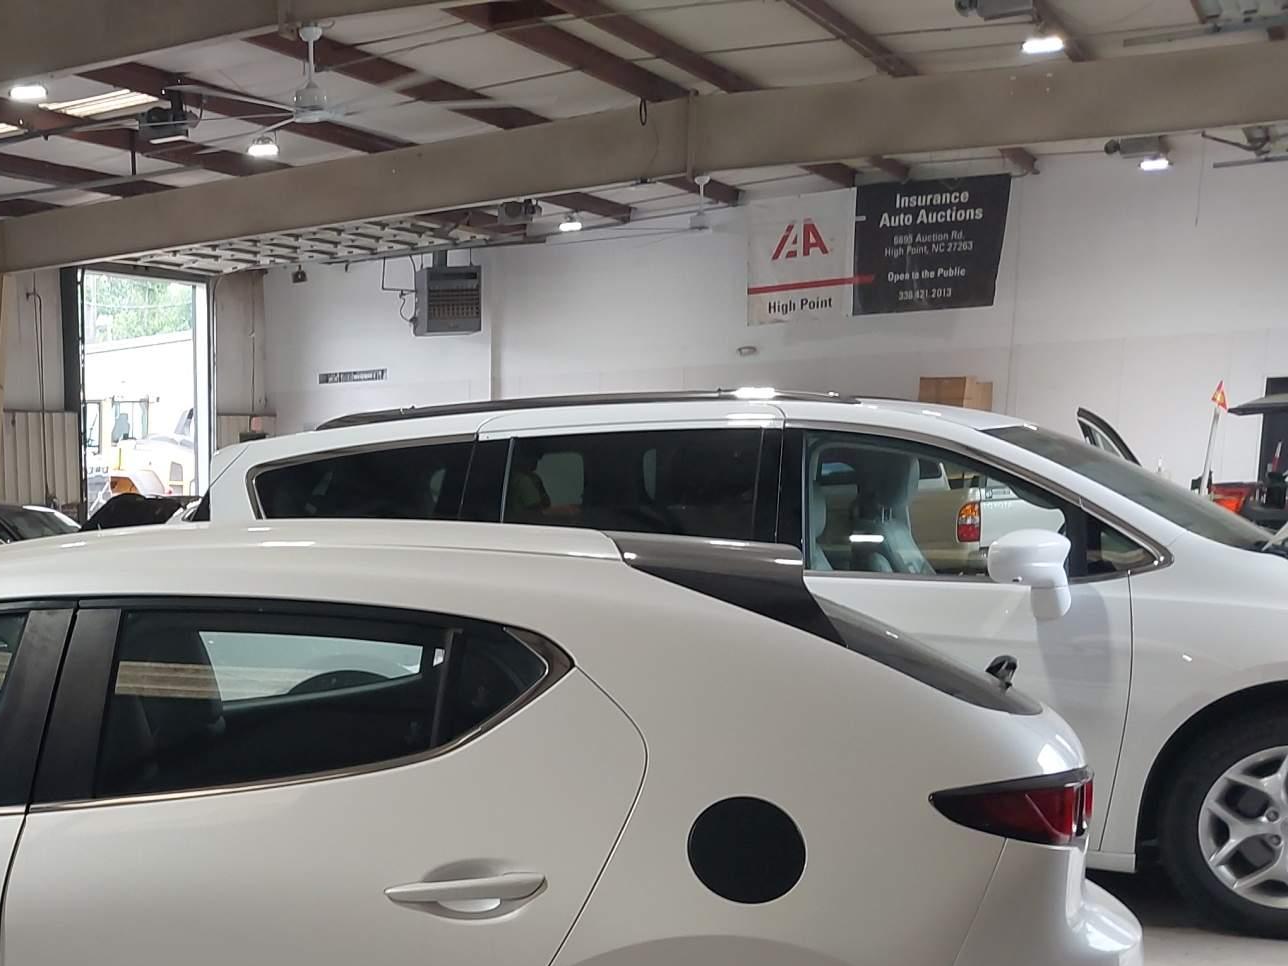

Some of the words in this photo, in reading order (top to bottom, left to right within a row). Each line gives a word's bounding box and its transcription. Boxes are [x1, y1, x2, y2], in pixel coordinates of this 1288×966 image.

[896, 191, 969, 209] Insurance
[879, 212, 913, 228] Auto
[916, 206, 984, 225] Auctions
[915, 232, 949, 243] Auction
[884, 247, 904, 258] High
[931, 242, 945, 253] NC
[888, 271, 910, 283] Open
[911, 271, 920, 280] to
[922, 270, 935, 279] the
[937, 266, 966, 277] Public
[768, 299, 796, 315] High
[800, 297, 832, 311] Point
